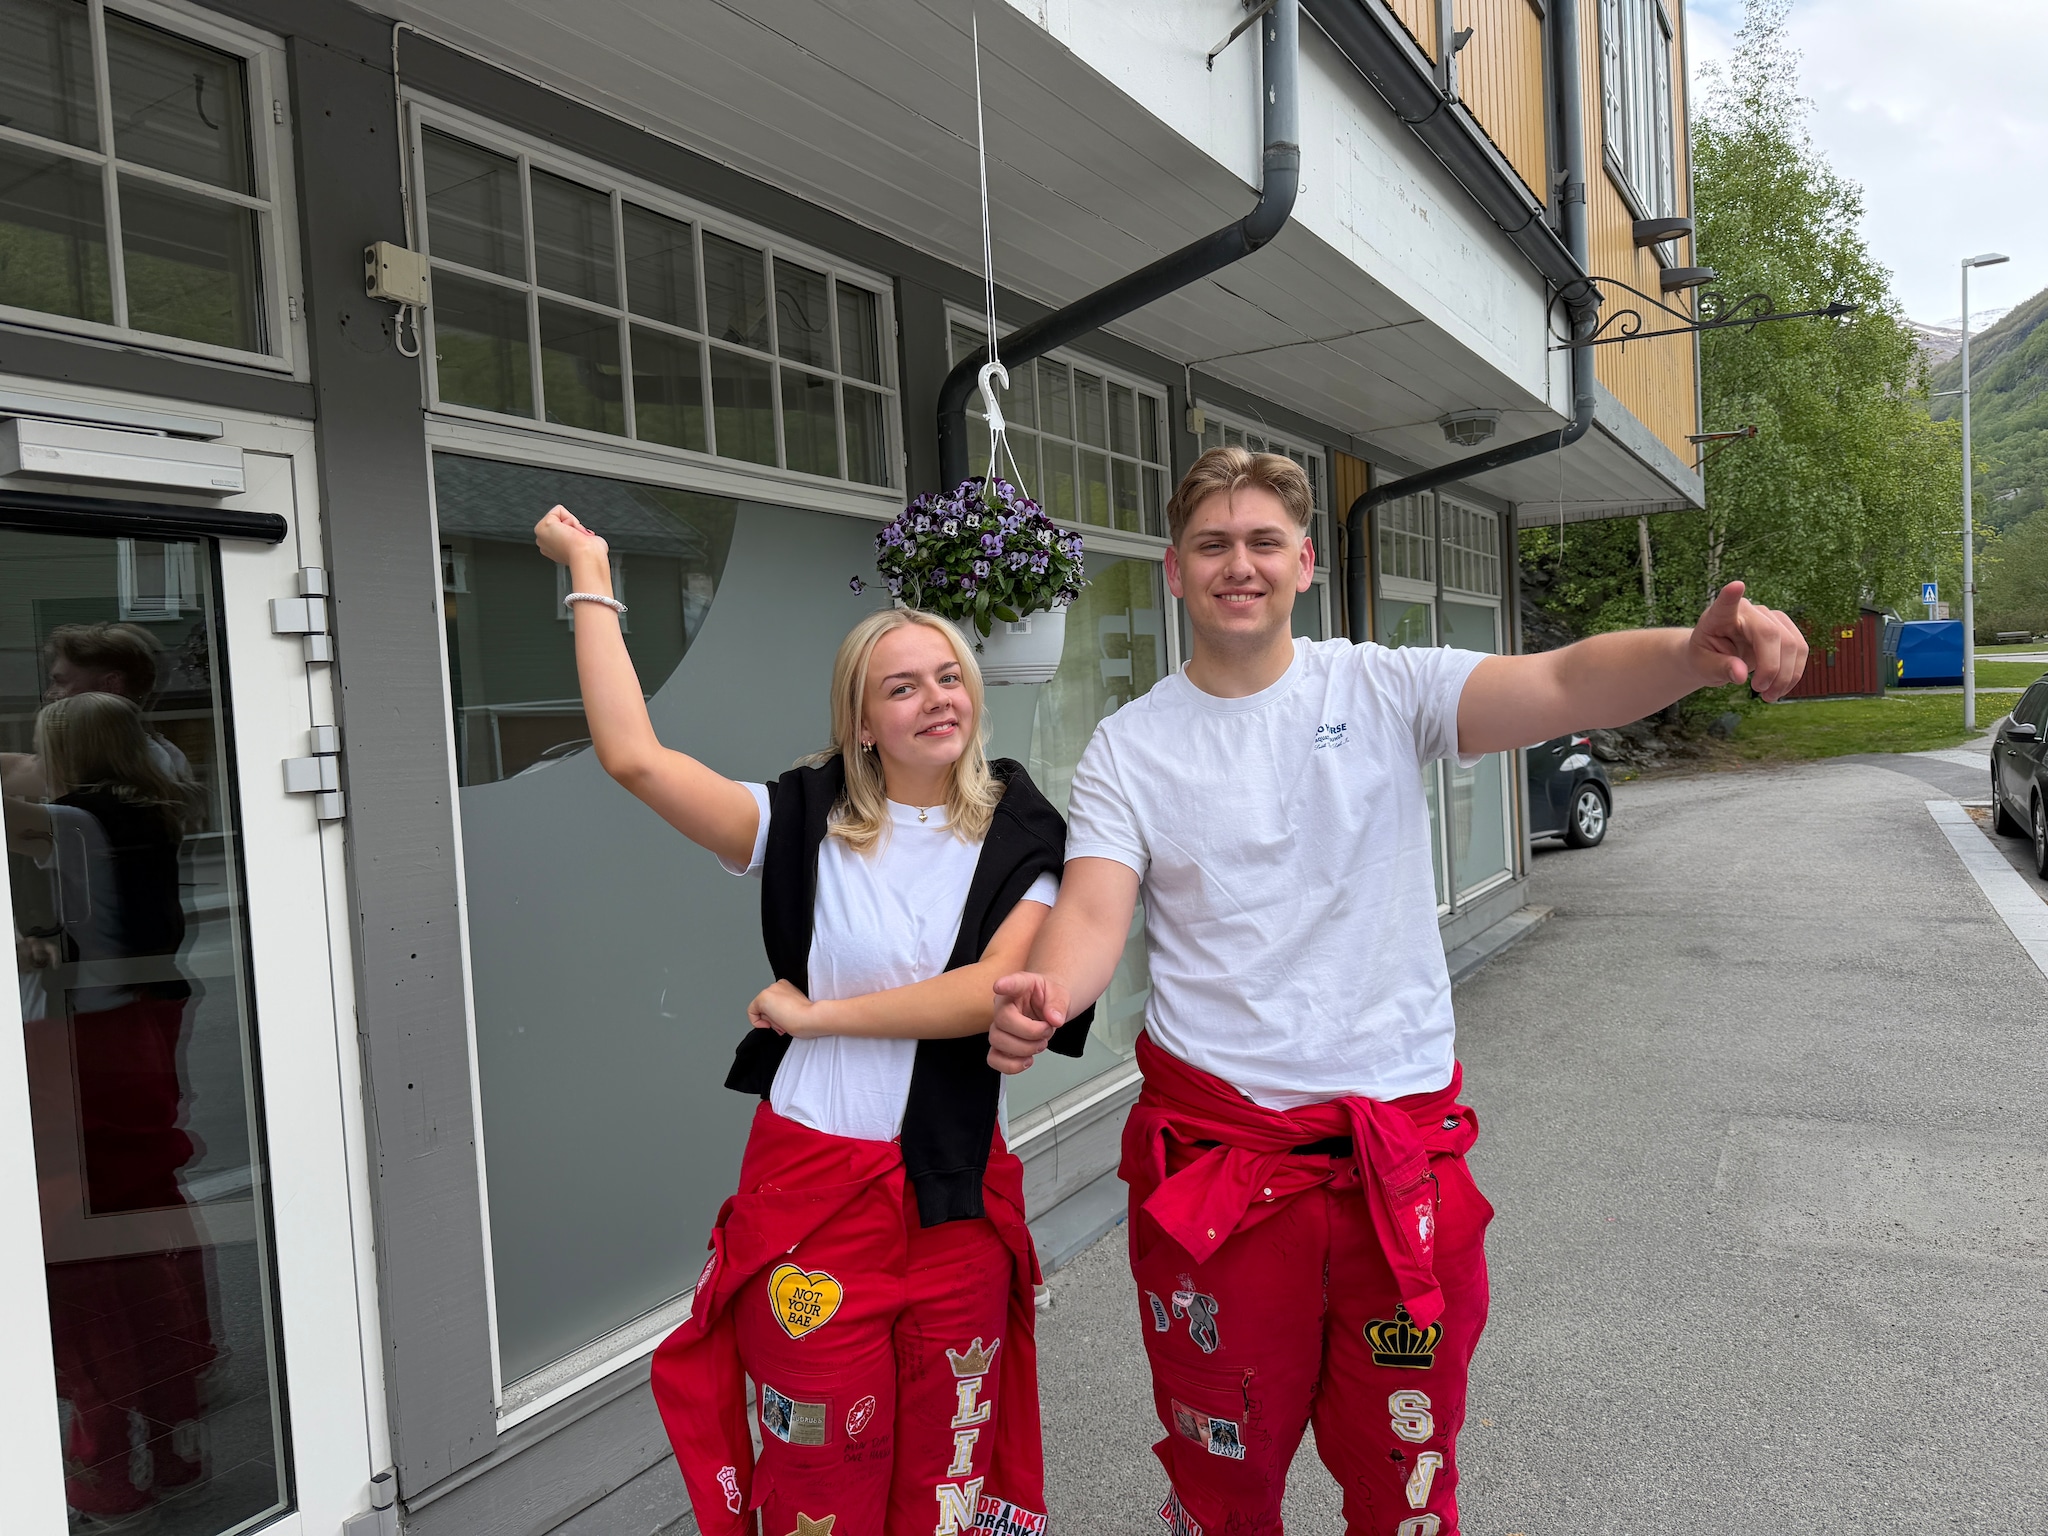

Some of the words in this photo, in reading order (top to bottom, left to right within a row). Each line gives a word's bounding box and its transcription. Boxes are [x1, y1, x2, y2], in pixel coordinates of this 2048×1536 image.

[792, 1287, 823, 1304] NOT
[788, 1298, 821, 1317] YOUR
[787, 1312, 812, 1328] BAE
[977, 1497, 1046, 1532] DRINK!
